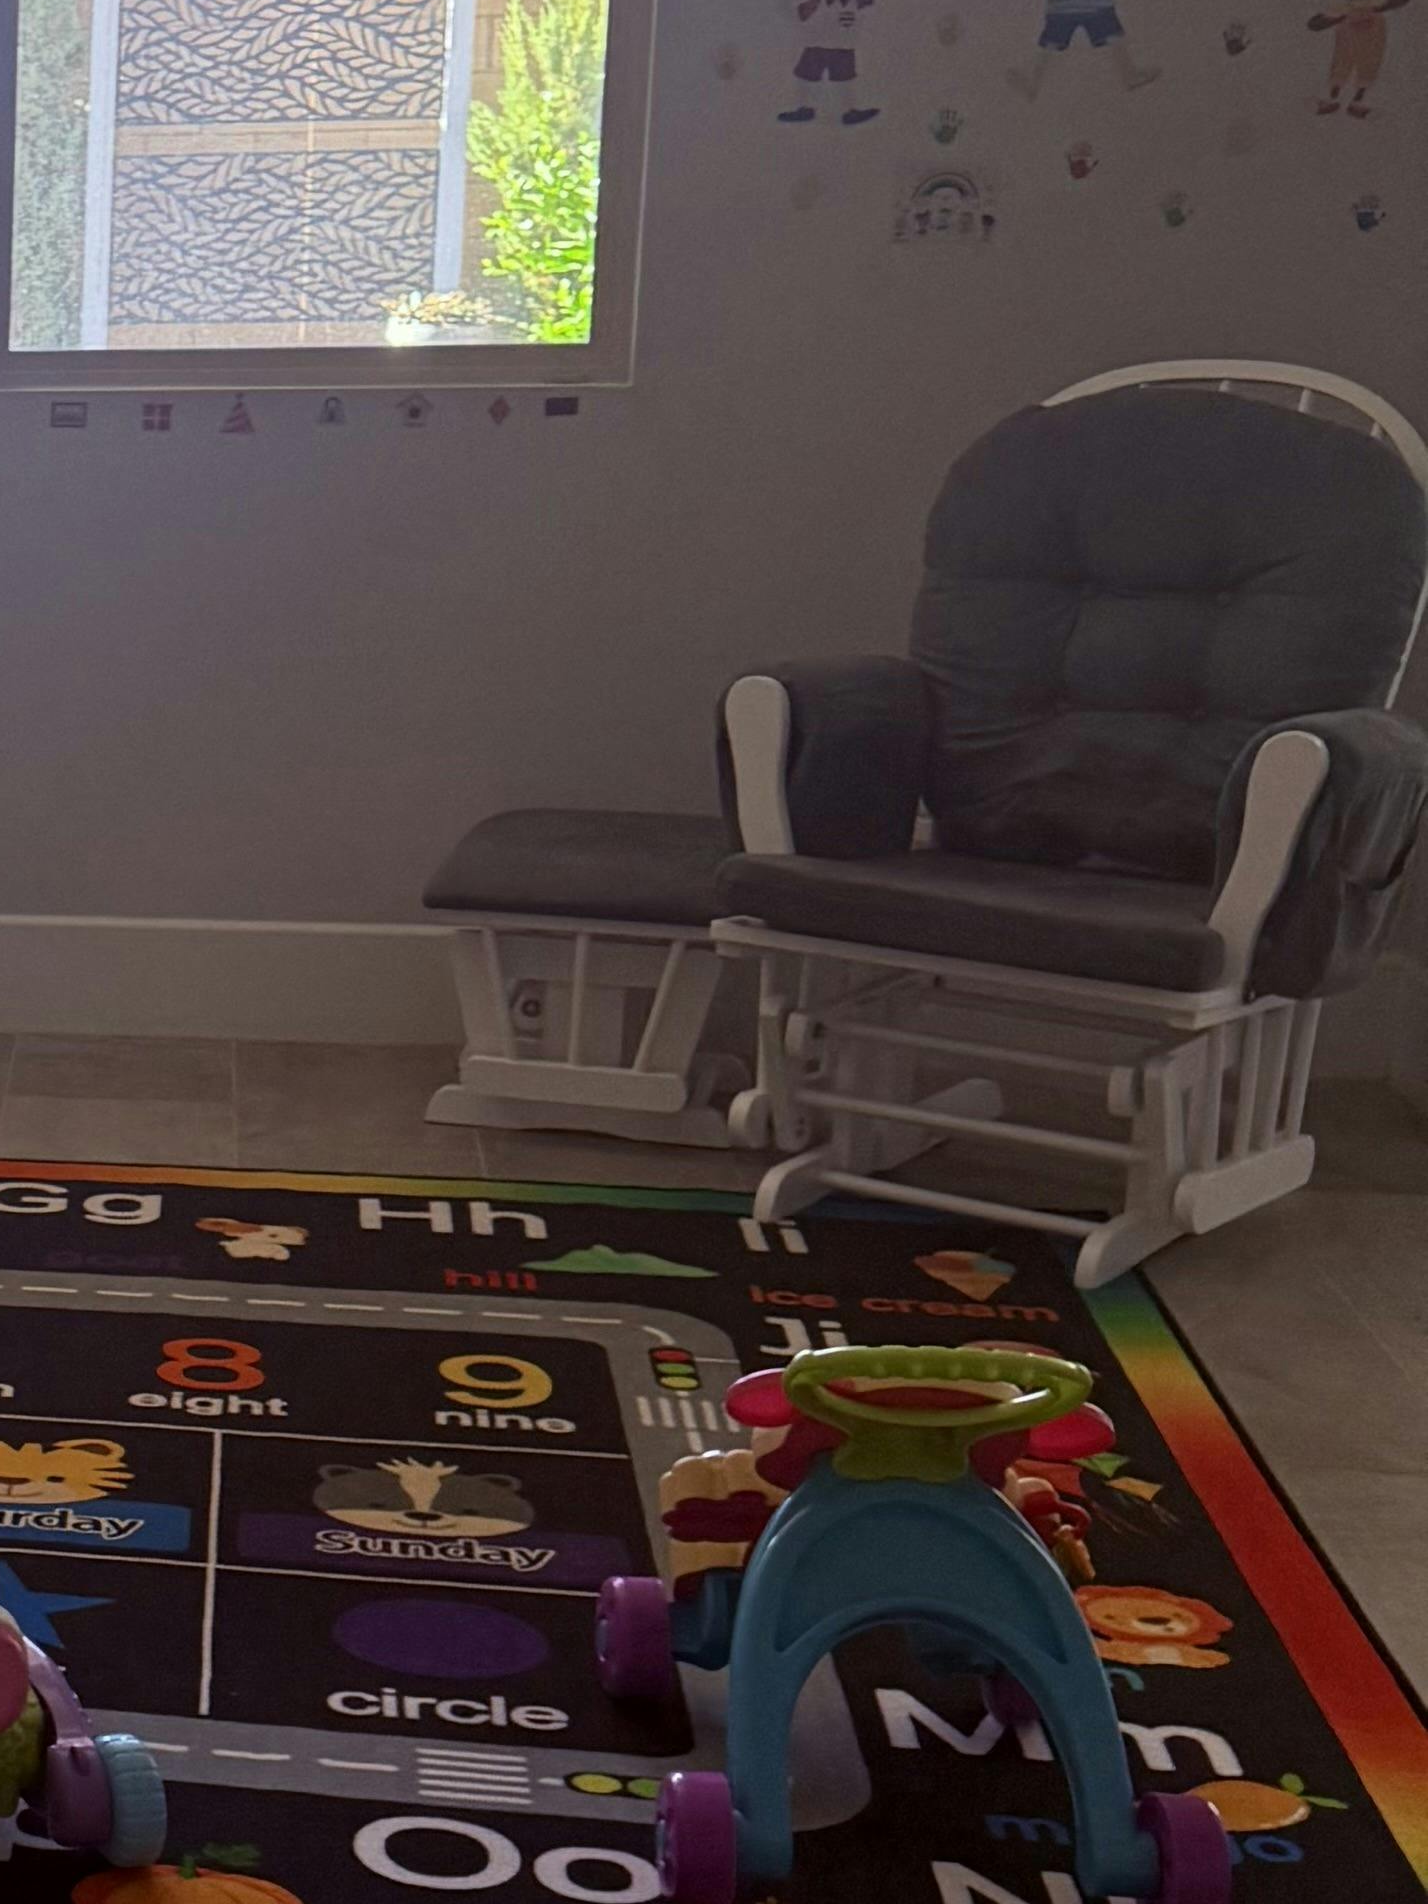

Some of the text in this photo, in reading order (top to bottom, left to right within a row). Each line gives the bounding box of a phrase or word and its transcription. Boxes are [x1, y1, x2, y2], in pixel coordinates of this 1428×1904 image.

[358, 1198, 548, 1240] Hh
[443, 1268, 539, 1292] hill
[861, 1298, 1060, 1322] cream
[155, 1337, 265, 1392] 8
[437, 1354, 553, 1408] 9
[128, 1392, 290, 1417] eight
[434, 1407, 577, 1435] nine
[314, 1528, 556, 1573] Sunday
[327, 1688, 569, 1730] circle
[353, 1816, 664, 1904] Oo
